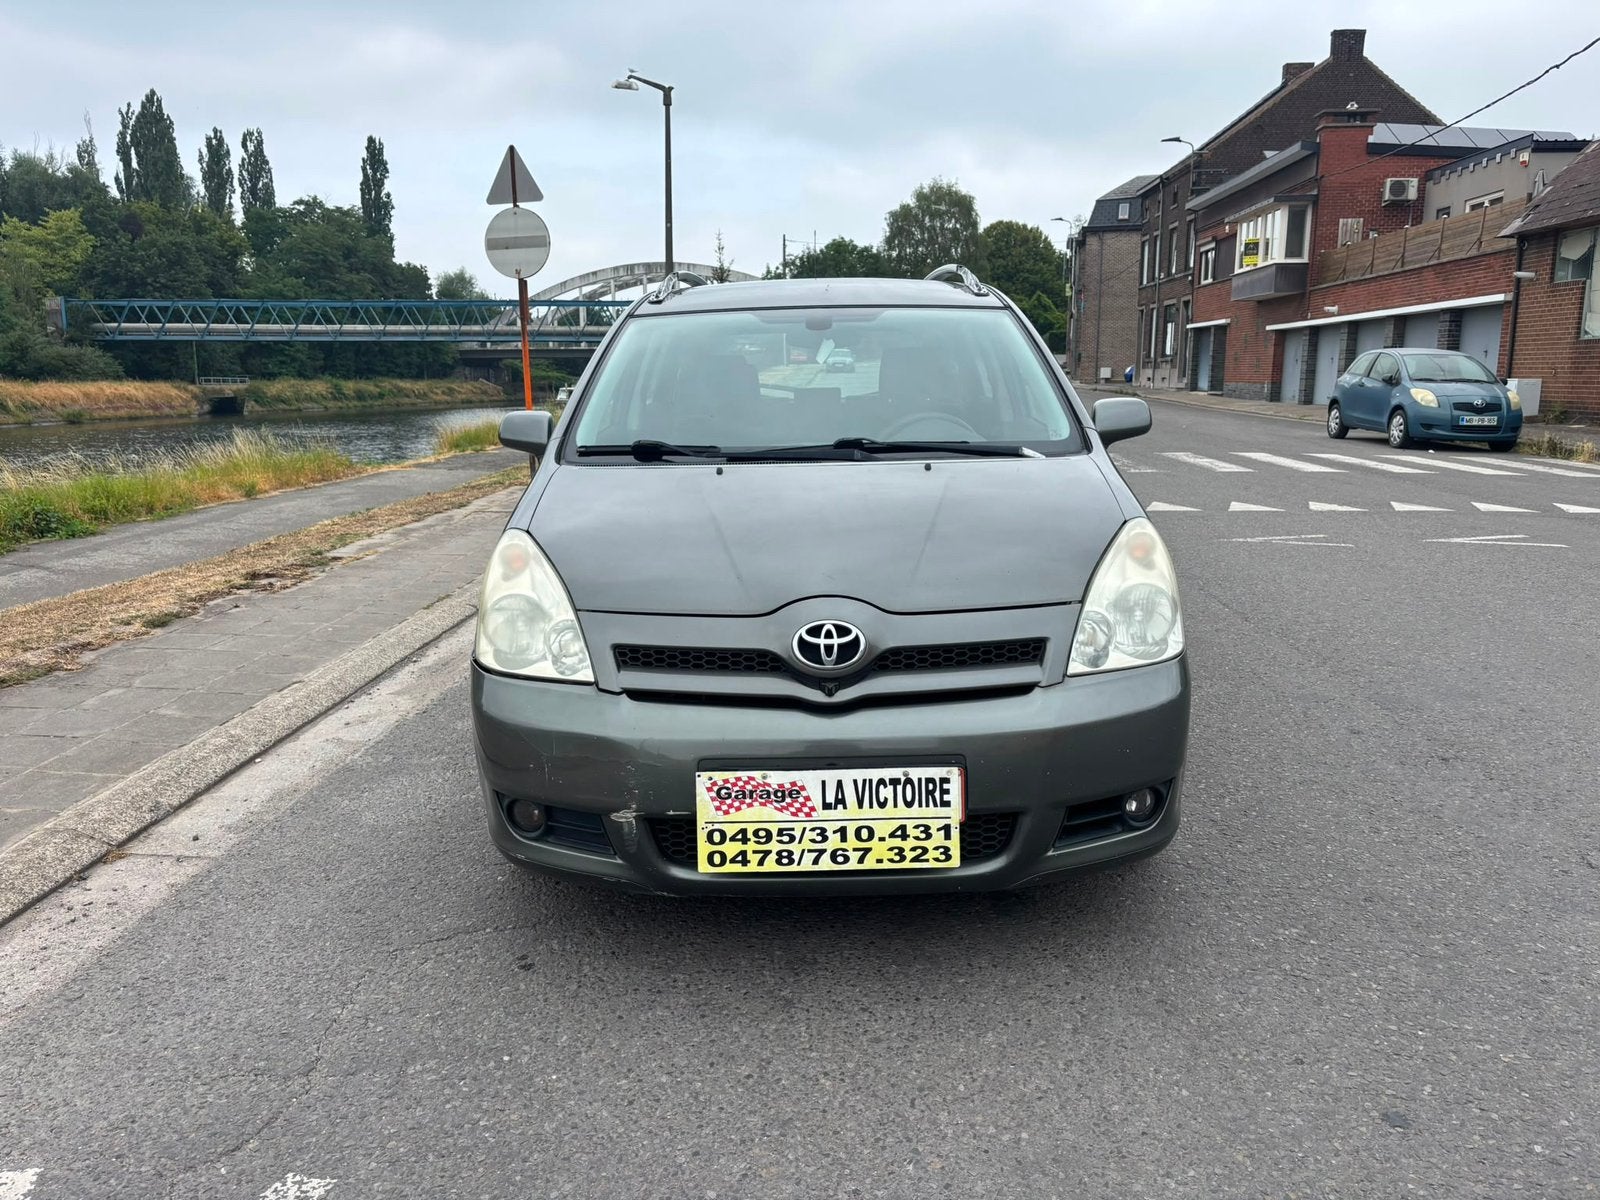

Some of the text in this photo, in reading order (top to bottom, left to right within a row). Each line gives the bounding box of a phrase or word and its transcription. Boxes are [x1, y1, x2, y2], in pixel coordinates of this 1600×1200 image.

[715, 776, 952, 811] Garage LA VICTOIRE
[706, 823, 952, 846] 0495/310.431
[706, 845, 953, 868] 0478/767.323
